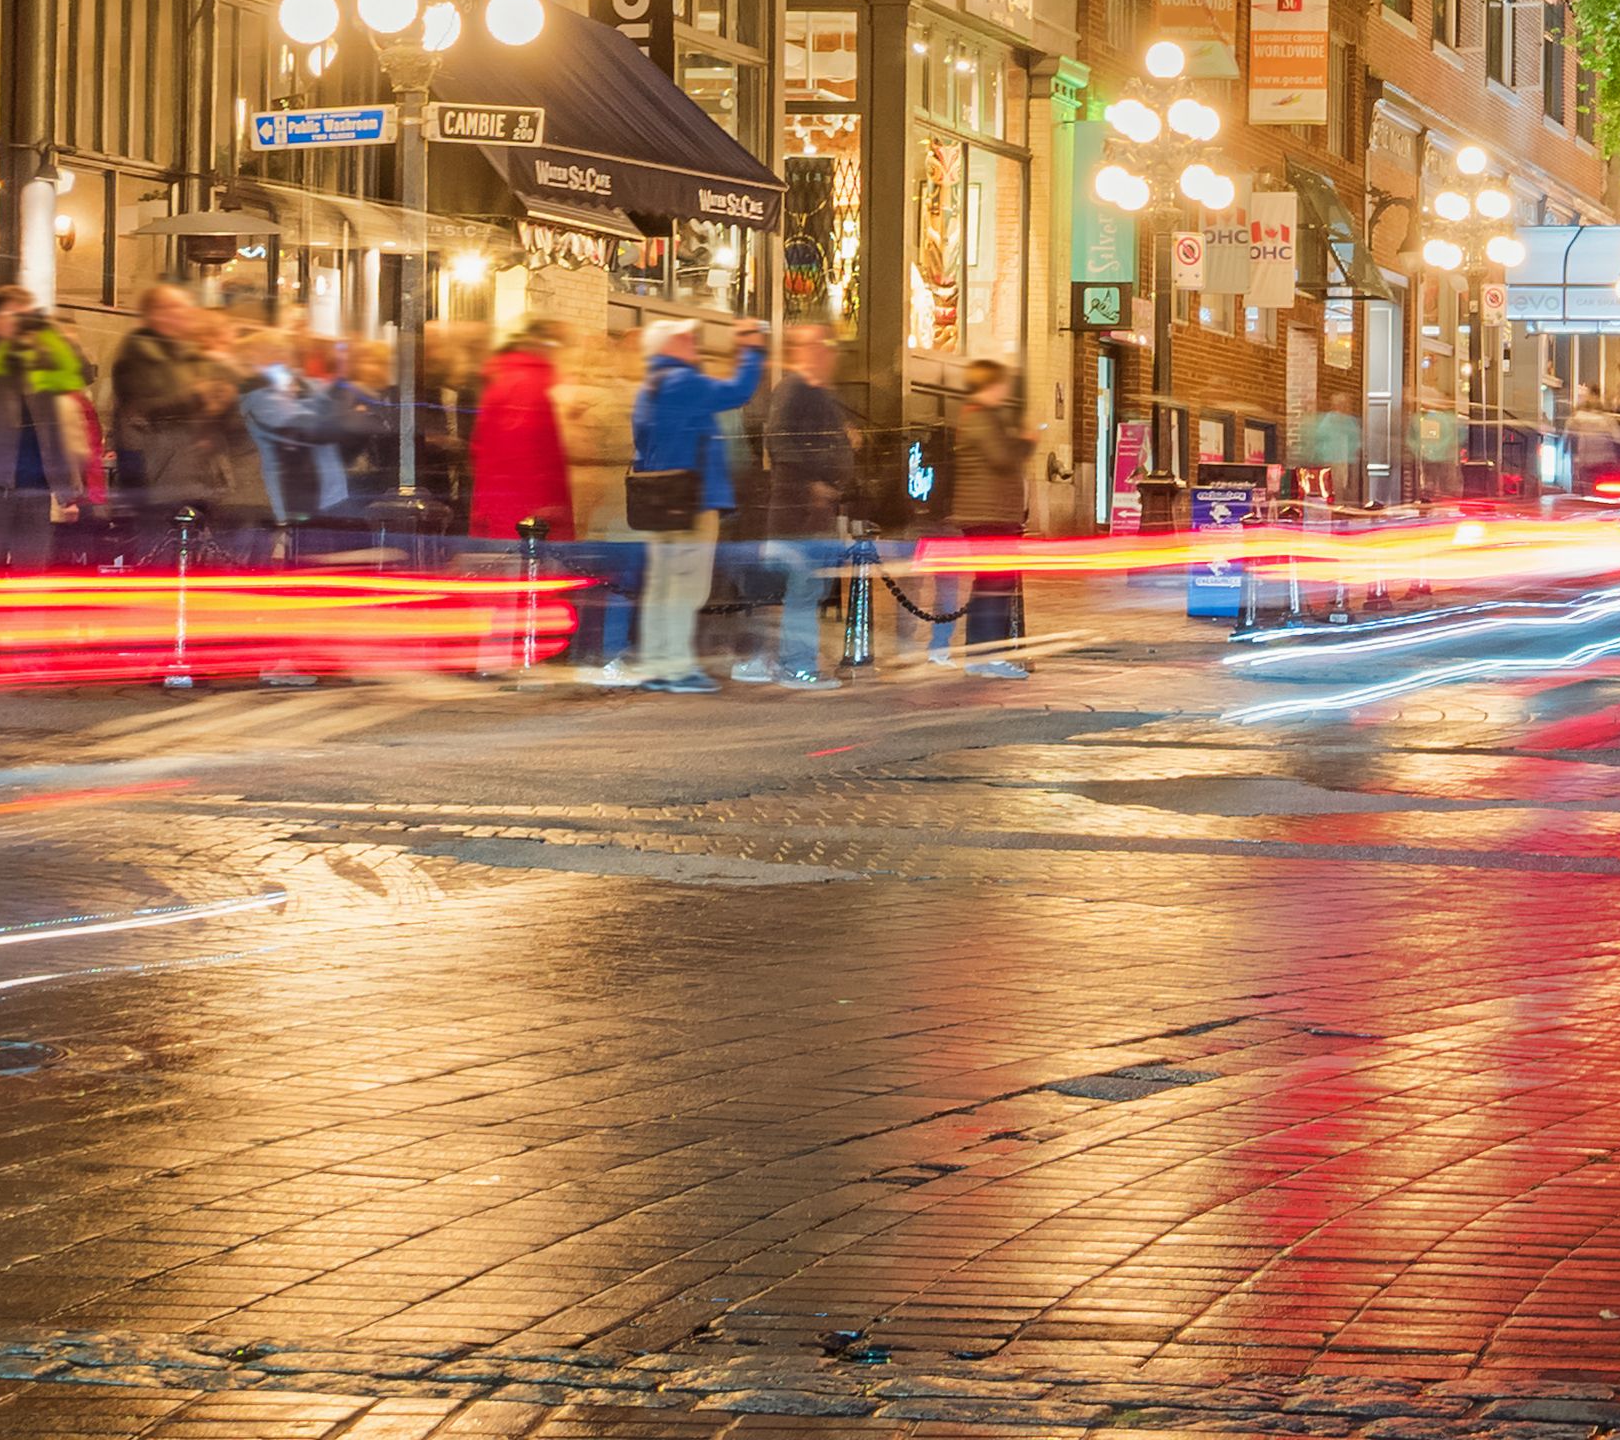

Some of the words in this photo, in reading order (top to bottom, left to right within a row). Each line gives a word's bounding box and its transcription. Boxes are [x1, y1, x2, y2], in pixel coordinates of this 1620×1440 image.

[1253, 44, 1325, 58] WORLDWIDE
[443, 110, 507, 138] CAMBIE
[517, 115, 530, 129] ST
[1512, 292, 1561, 313] evo
